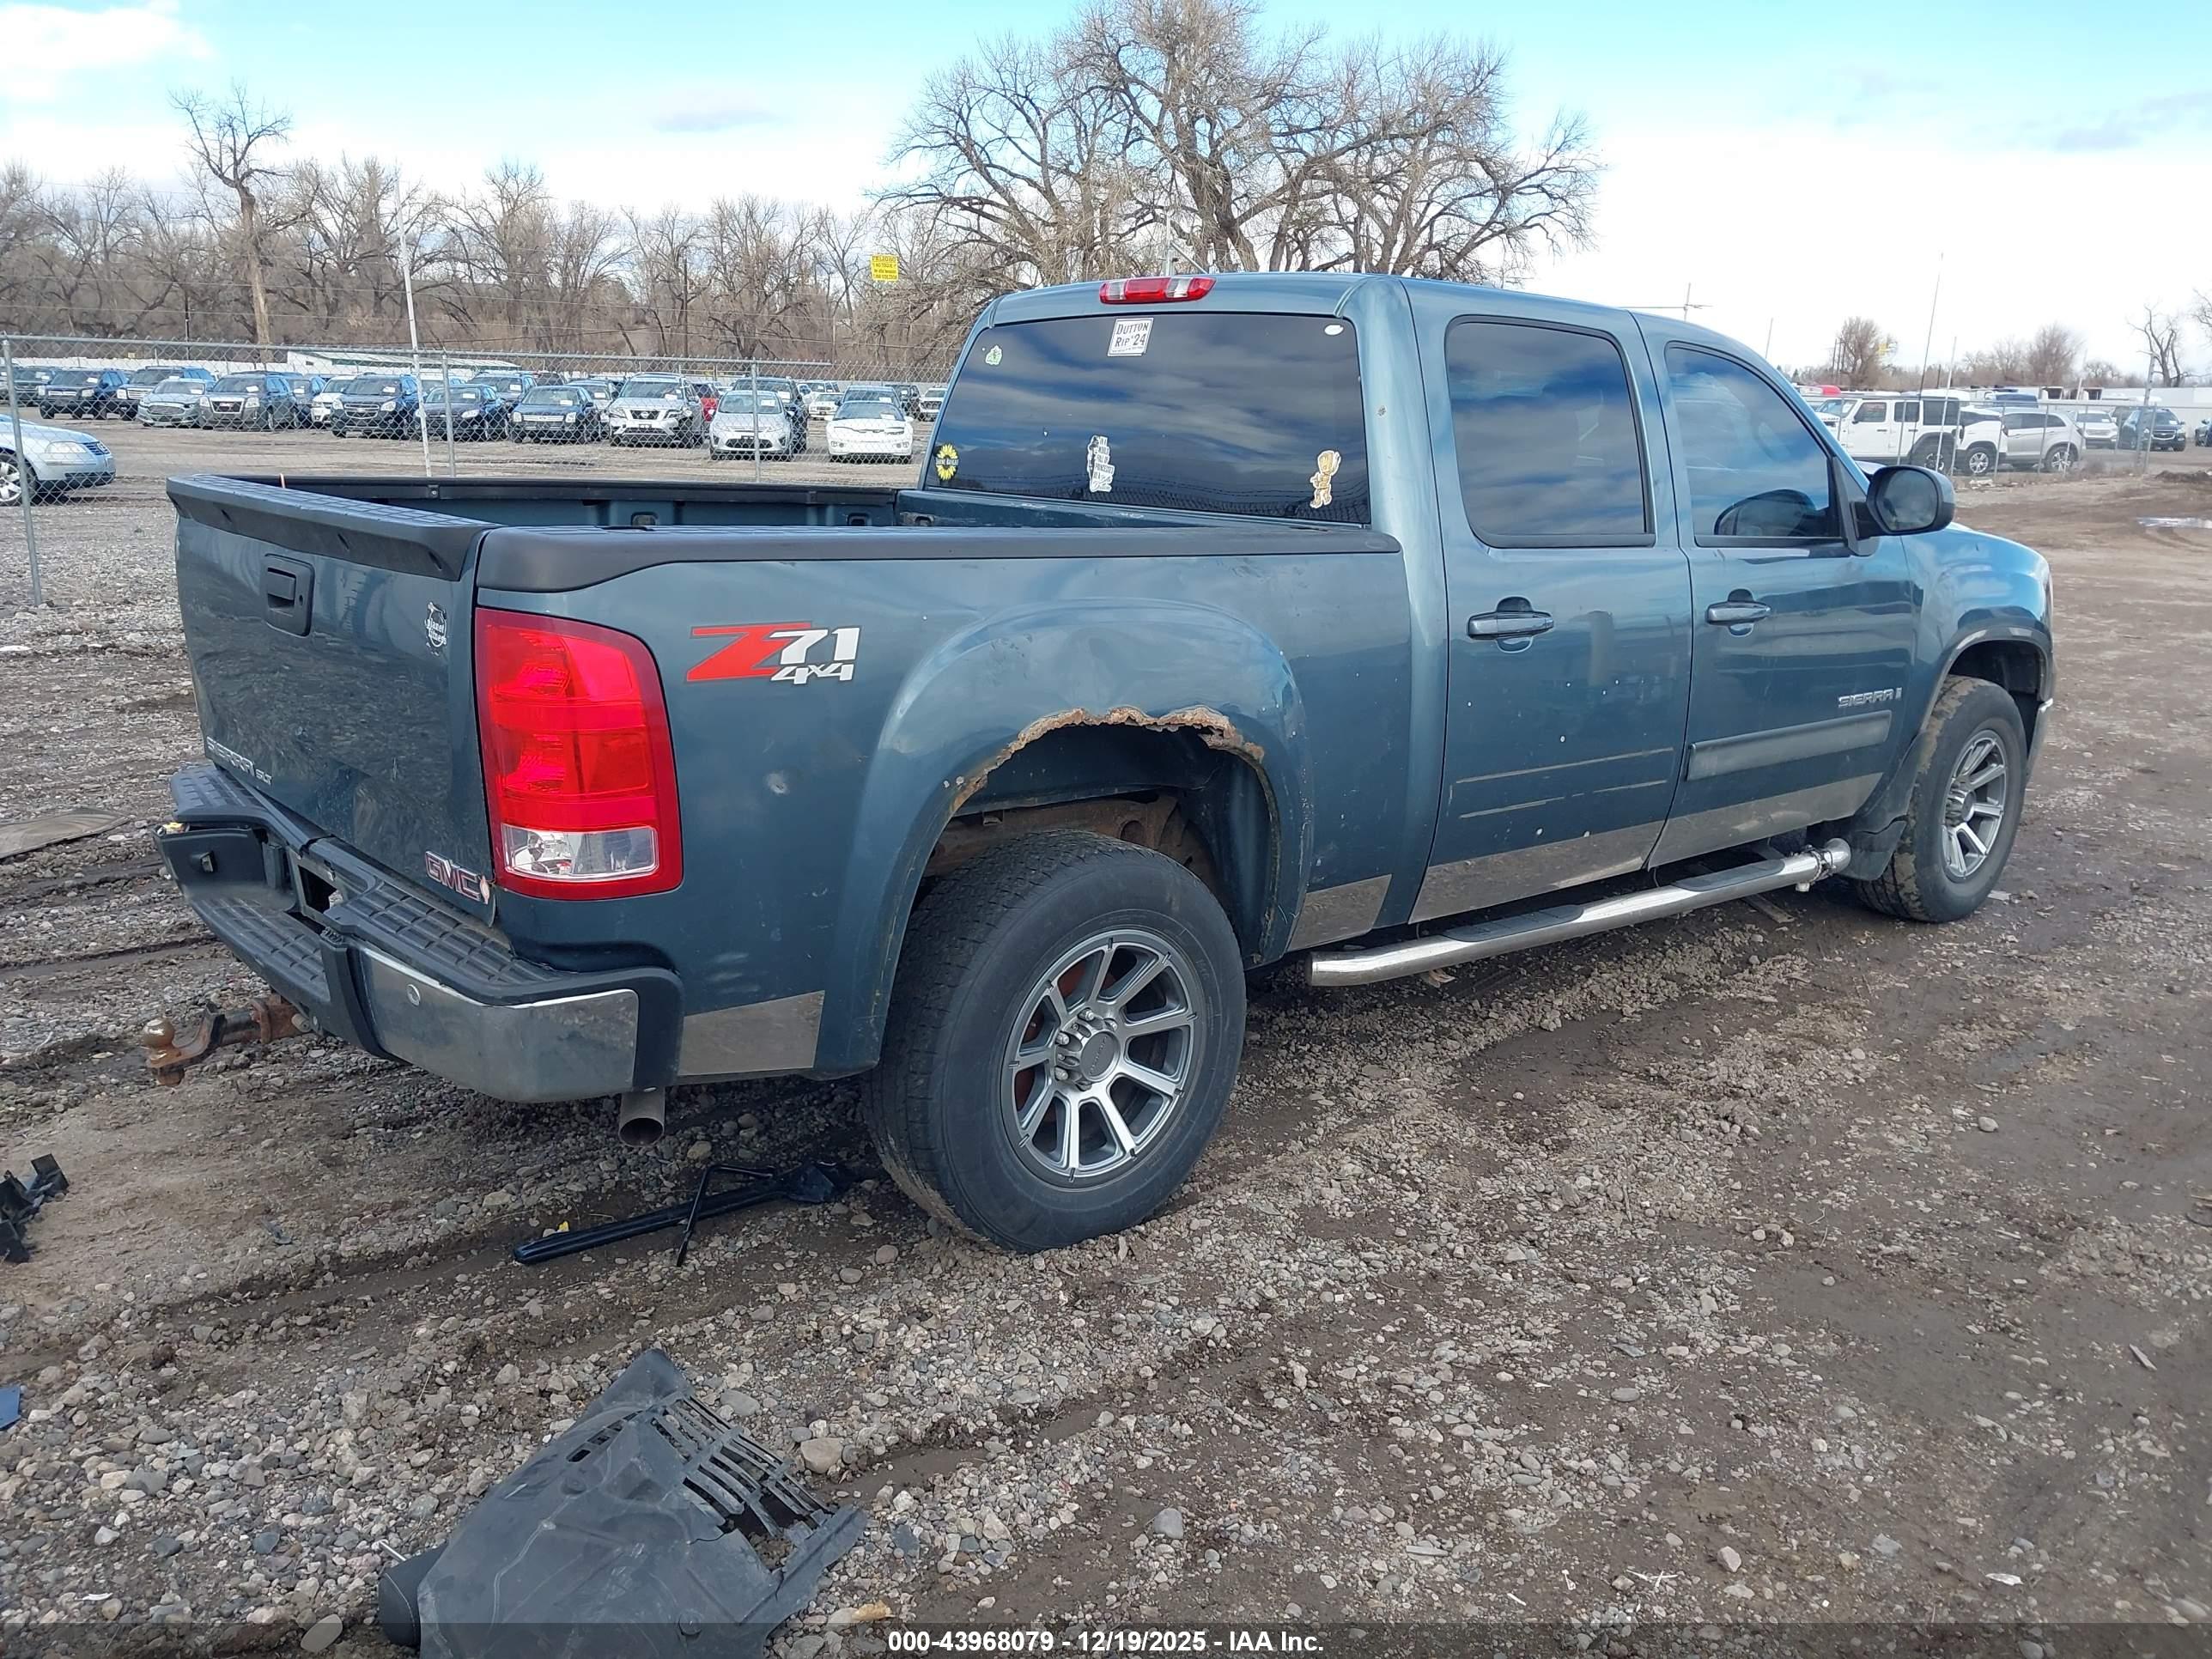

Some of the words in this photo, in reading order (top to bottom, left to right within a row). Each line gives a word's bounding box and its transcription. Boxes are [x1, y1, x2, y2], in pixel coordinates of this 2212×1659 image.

[1115, 322, 1149, 335] DUTTON
[685, 621, 860, 683] Z71
[1838, 688, 1894, 708] SIERRA
[206, 736, 255, 776] SIERRA
[255, 769, 272, 786] SLT
[425, 851, 482, 902] GMC
